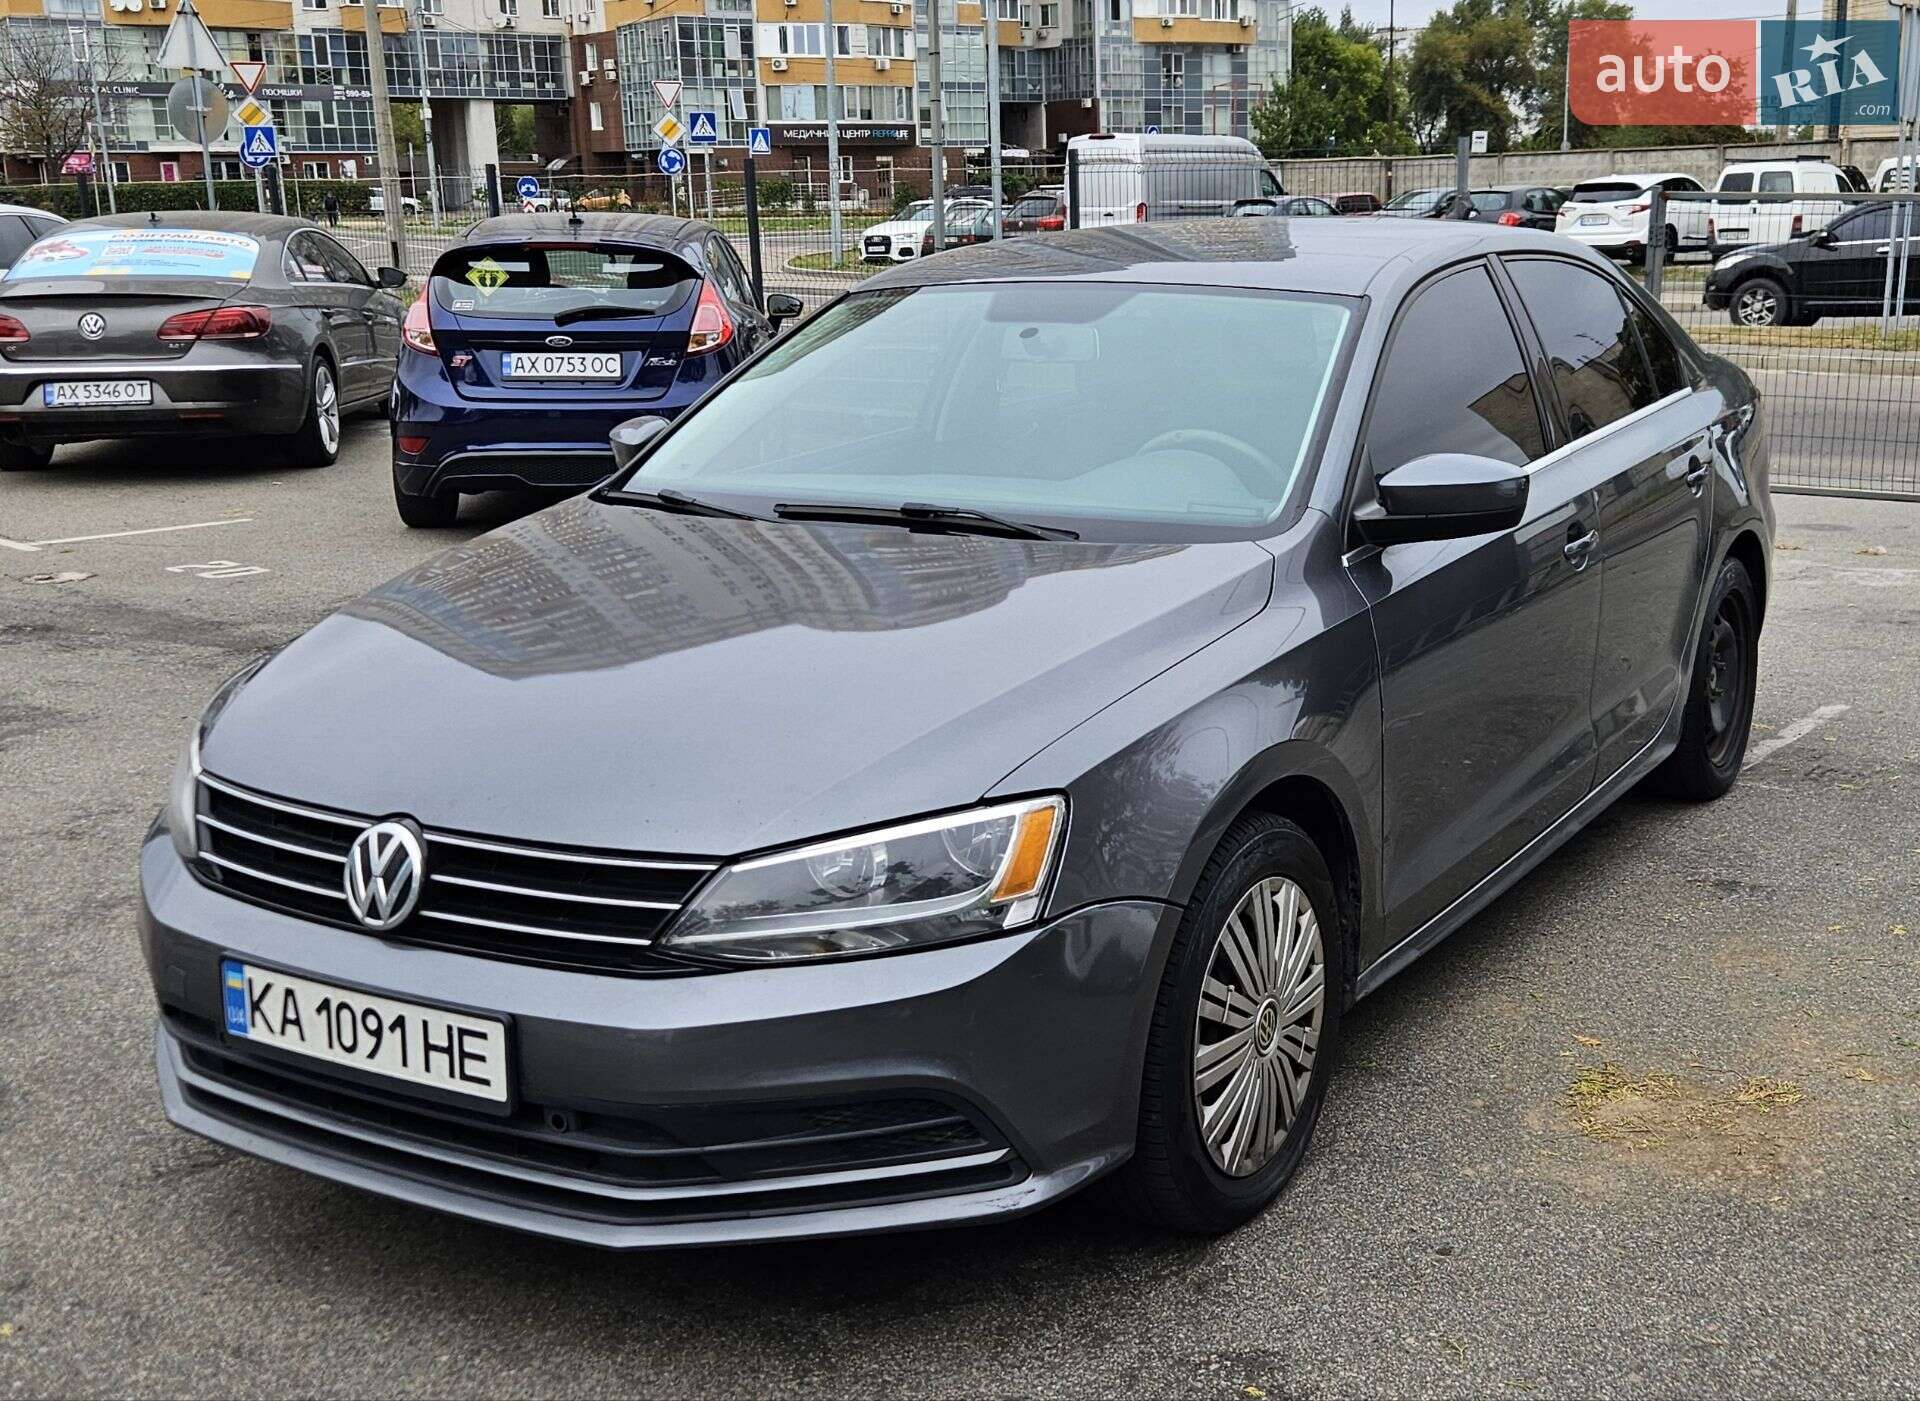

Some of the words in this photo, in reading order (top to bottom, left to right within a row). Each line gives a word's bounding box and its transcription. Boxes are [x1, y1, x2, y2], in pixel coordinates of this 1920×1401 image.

[113, 86, 140, 94] CLINIC
[842, 129, 871, 139] ЦЕНТР
[203, 236, 251, 248] АВТО
[514, 357, 541, 373] AX
[543, 357, 587, 373] 0753
[56, 385, 79, 400] AX
[84, 384, 121, 399] 5346
[124, 383, 147, 398] OT
[247, 977, 305, 1042] KA
[315, 997, 409, 1068] 1091
[422, 1020, 491, 1087] HE
